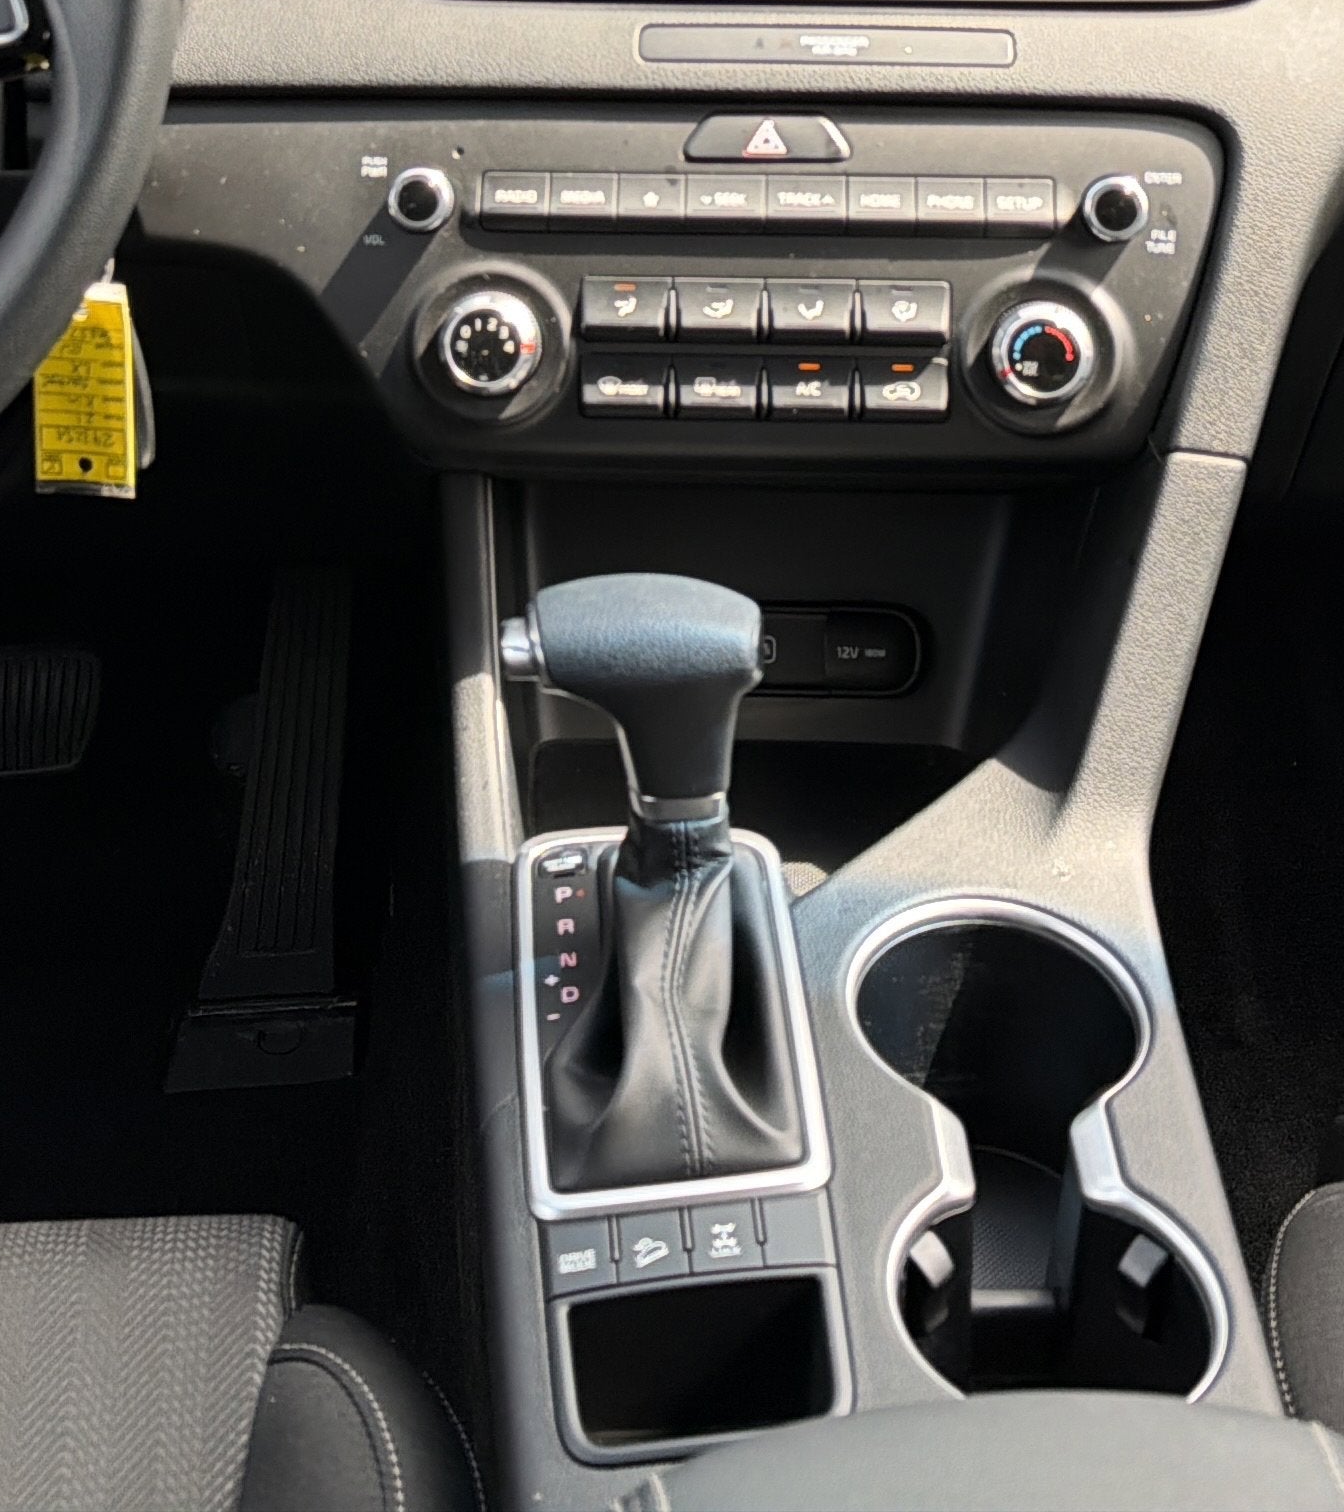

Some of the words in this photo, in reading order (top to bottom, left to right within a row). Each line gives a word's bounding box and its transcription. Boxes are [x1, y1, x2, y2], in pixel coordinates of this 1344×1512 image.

[494, 189, 538, 204] RADIO
[776, 191, 822, 207] TRACK
[859, 193, 901, 209] HOME
[995, 195, 1044, 211] SETUP
[363, 234, 385, 246] VOL
[459, 324, 472, 339] 0
[486, 317, 498, 332] 2
[795, 380, 822, 397] A/C
[836, 645, 860, 660] 12V
[554, 886, 573, 904] P
[557, 918, 575, 936] R
[559, 951, 578, 969] N
[560, 986, 580, 1004] D
